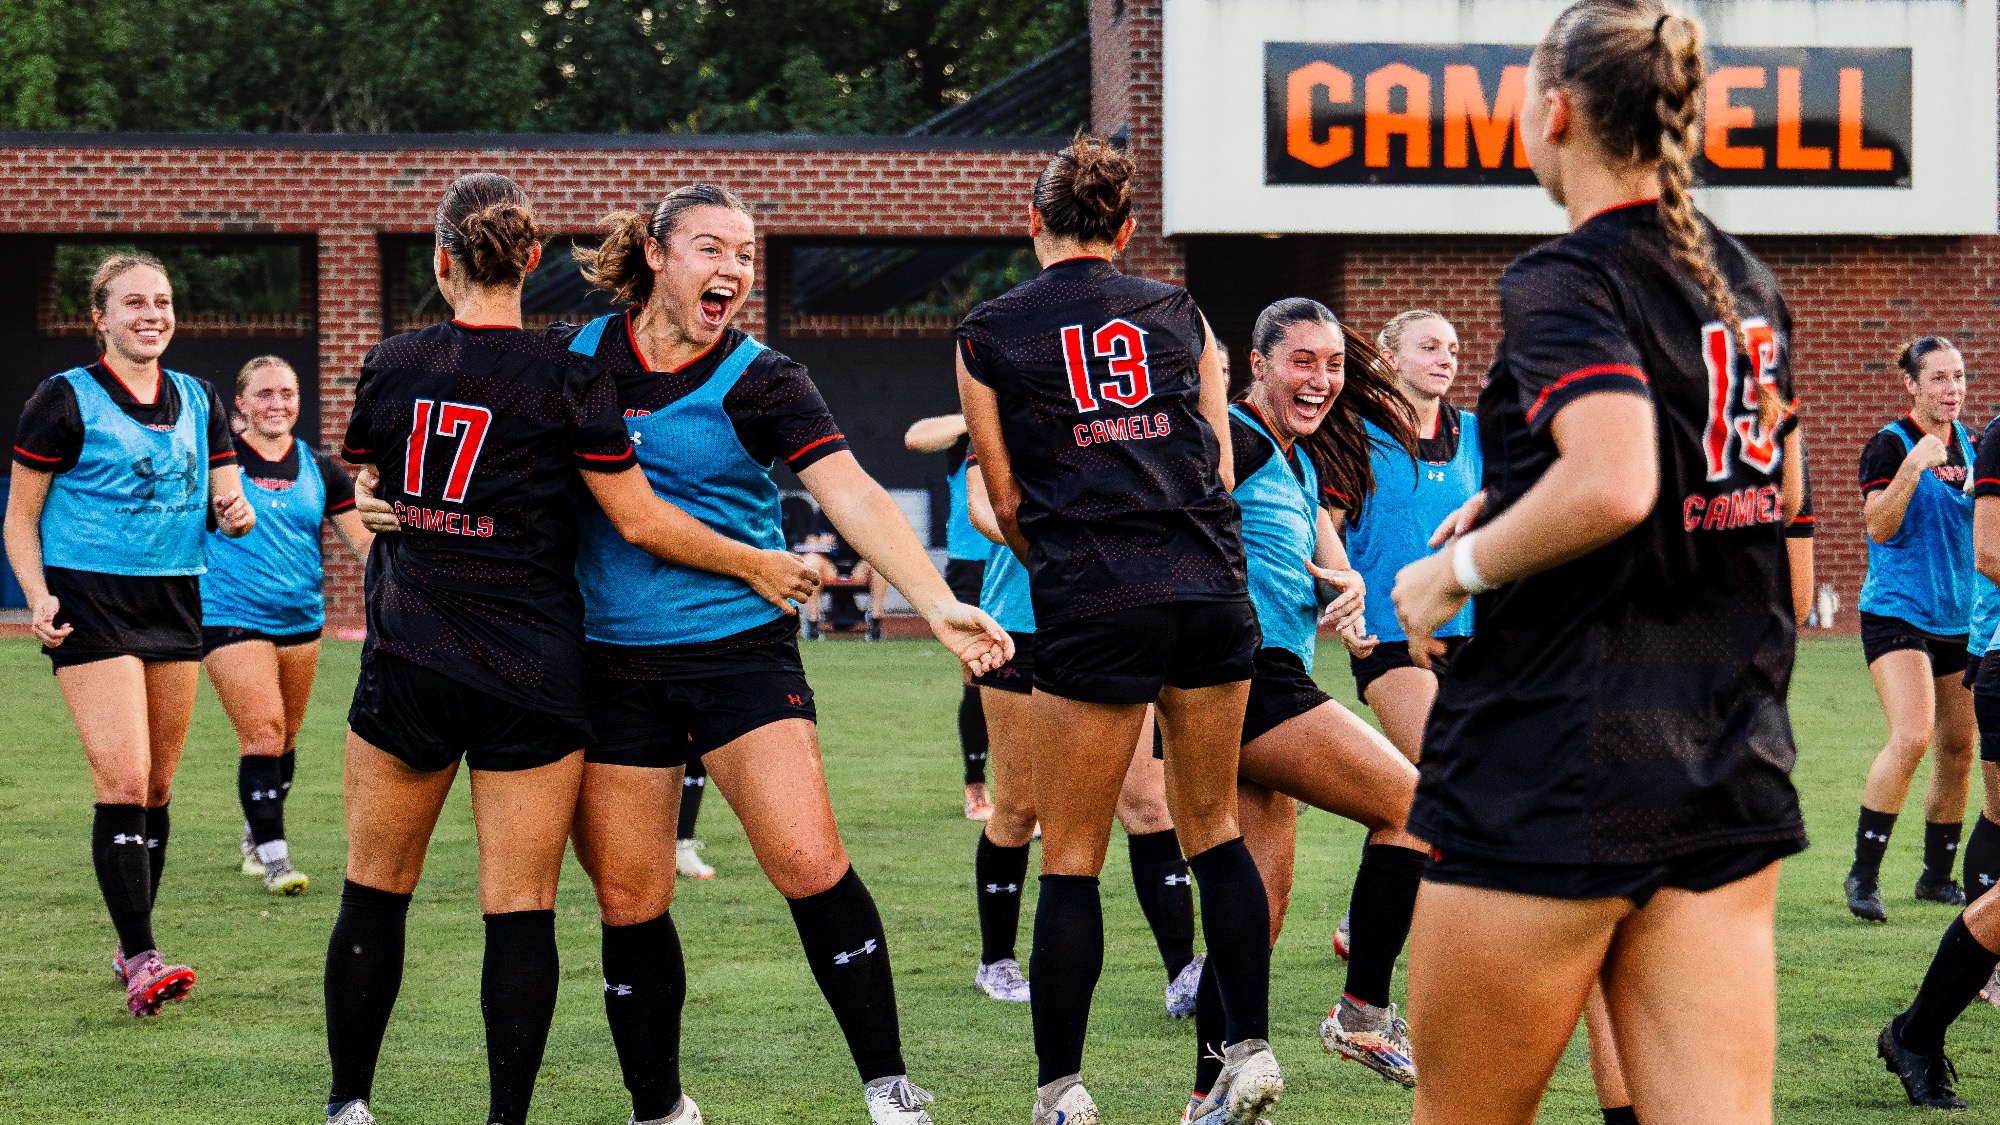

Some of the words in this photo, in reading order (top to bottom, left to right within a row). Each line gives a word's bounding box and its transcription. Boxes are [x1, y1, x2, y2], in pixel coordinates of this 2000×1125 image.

[1286, 60, 1893, 170] CAMELL
[1061, 318, 1154, 413] 13
[1701, 317, 1783, 482] 15
[404, 398, 492, 503] 17
[1073, 413, 1171, 447] CAMELS
[394, 500, 495, 538] CAMELS
[1683, 484, 1784, 532] CAME
